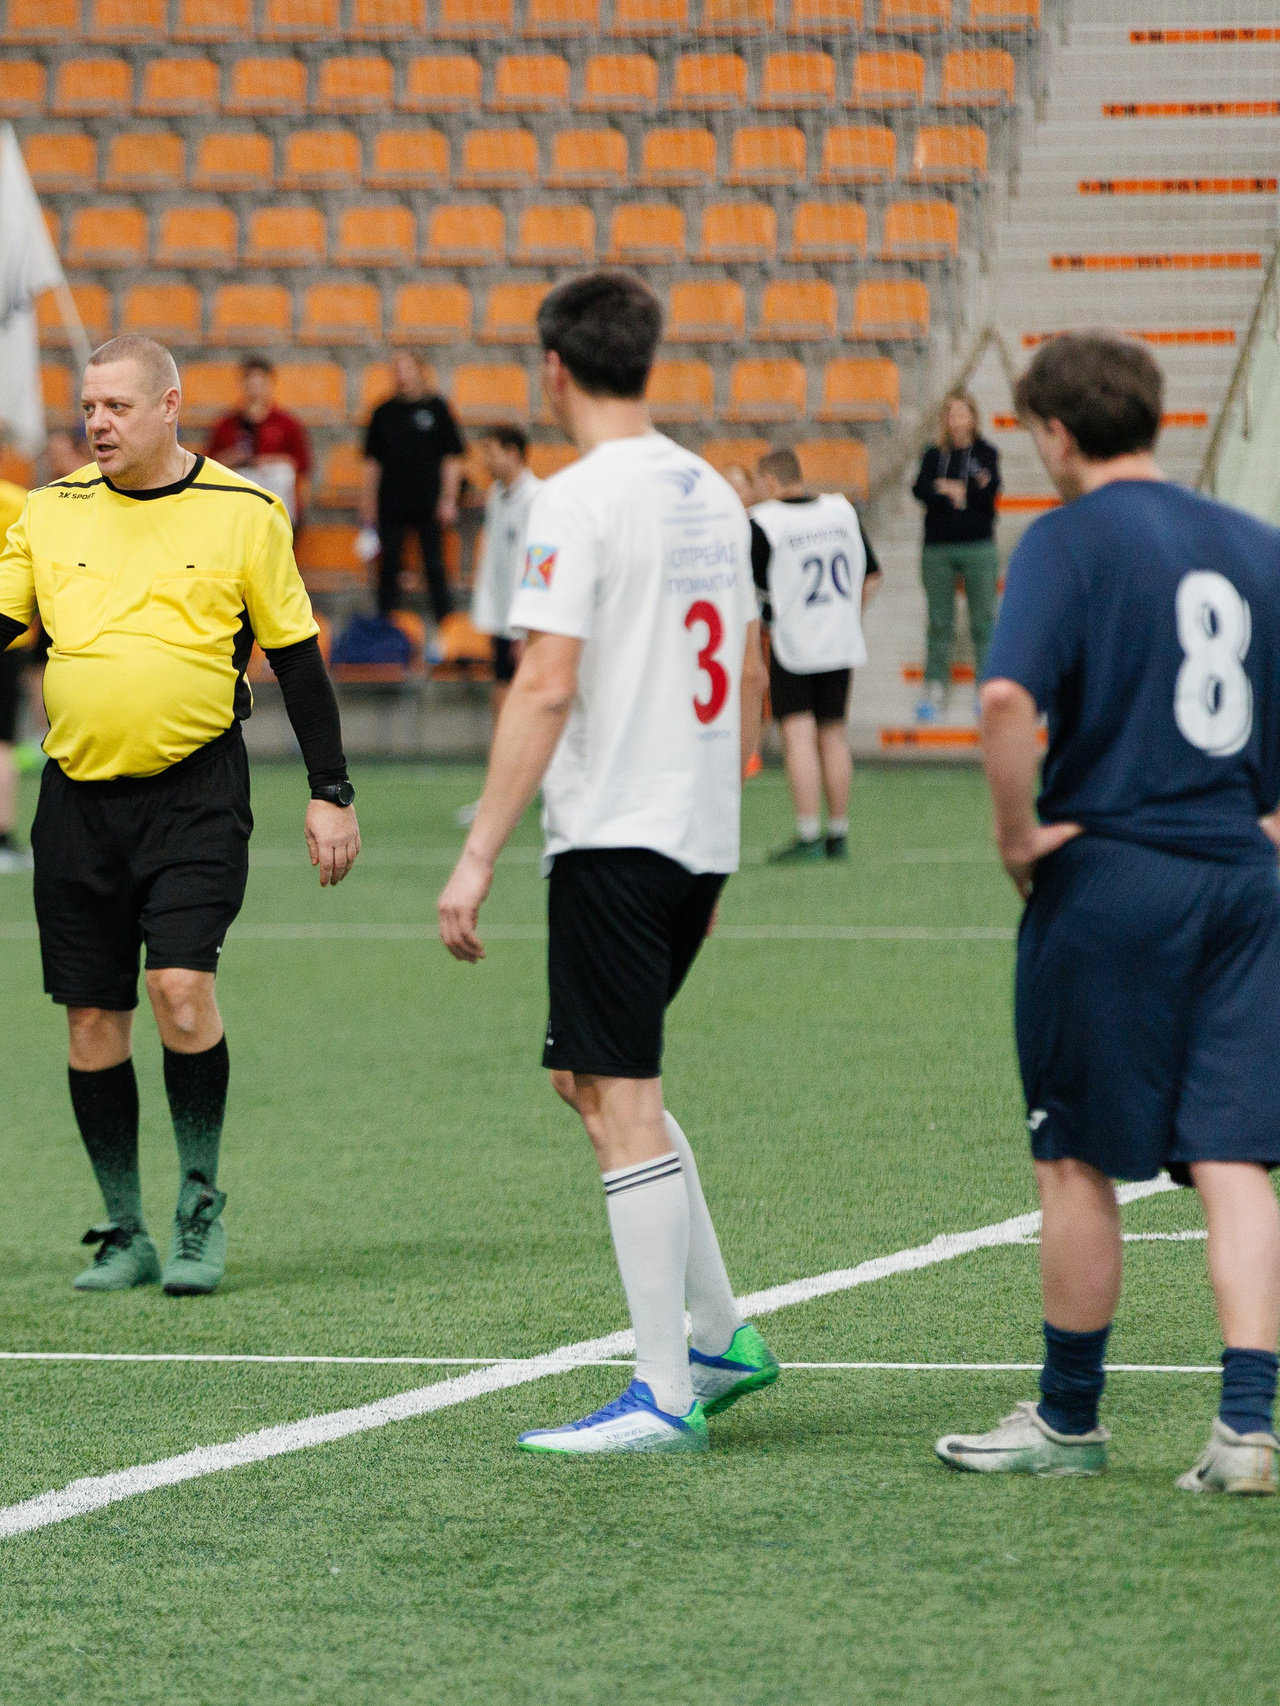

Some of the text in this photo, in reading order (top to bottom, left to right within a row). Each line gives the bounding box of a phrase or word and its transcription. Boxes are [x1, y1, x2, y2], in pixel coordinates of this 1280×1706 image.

[72, 492, 96, 500] SPORT
[802, 550, 852, 608] 20
[684, 598, 730, 725] 3
[1174, 569, 1254, 757] 8
